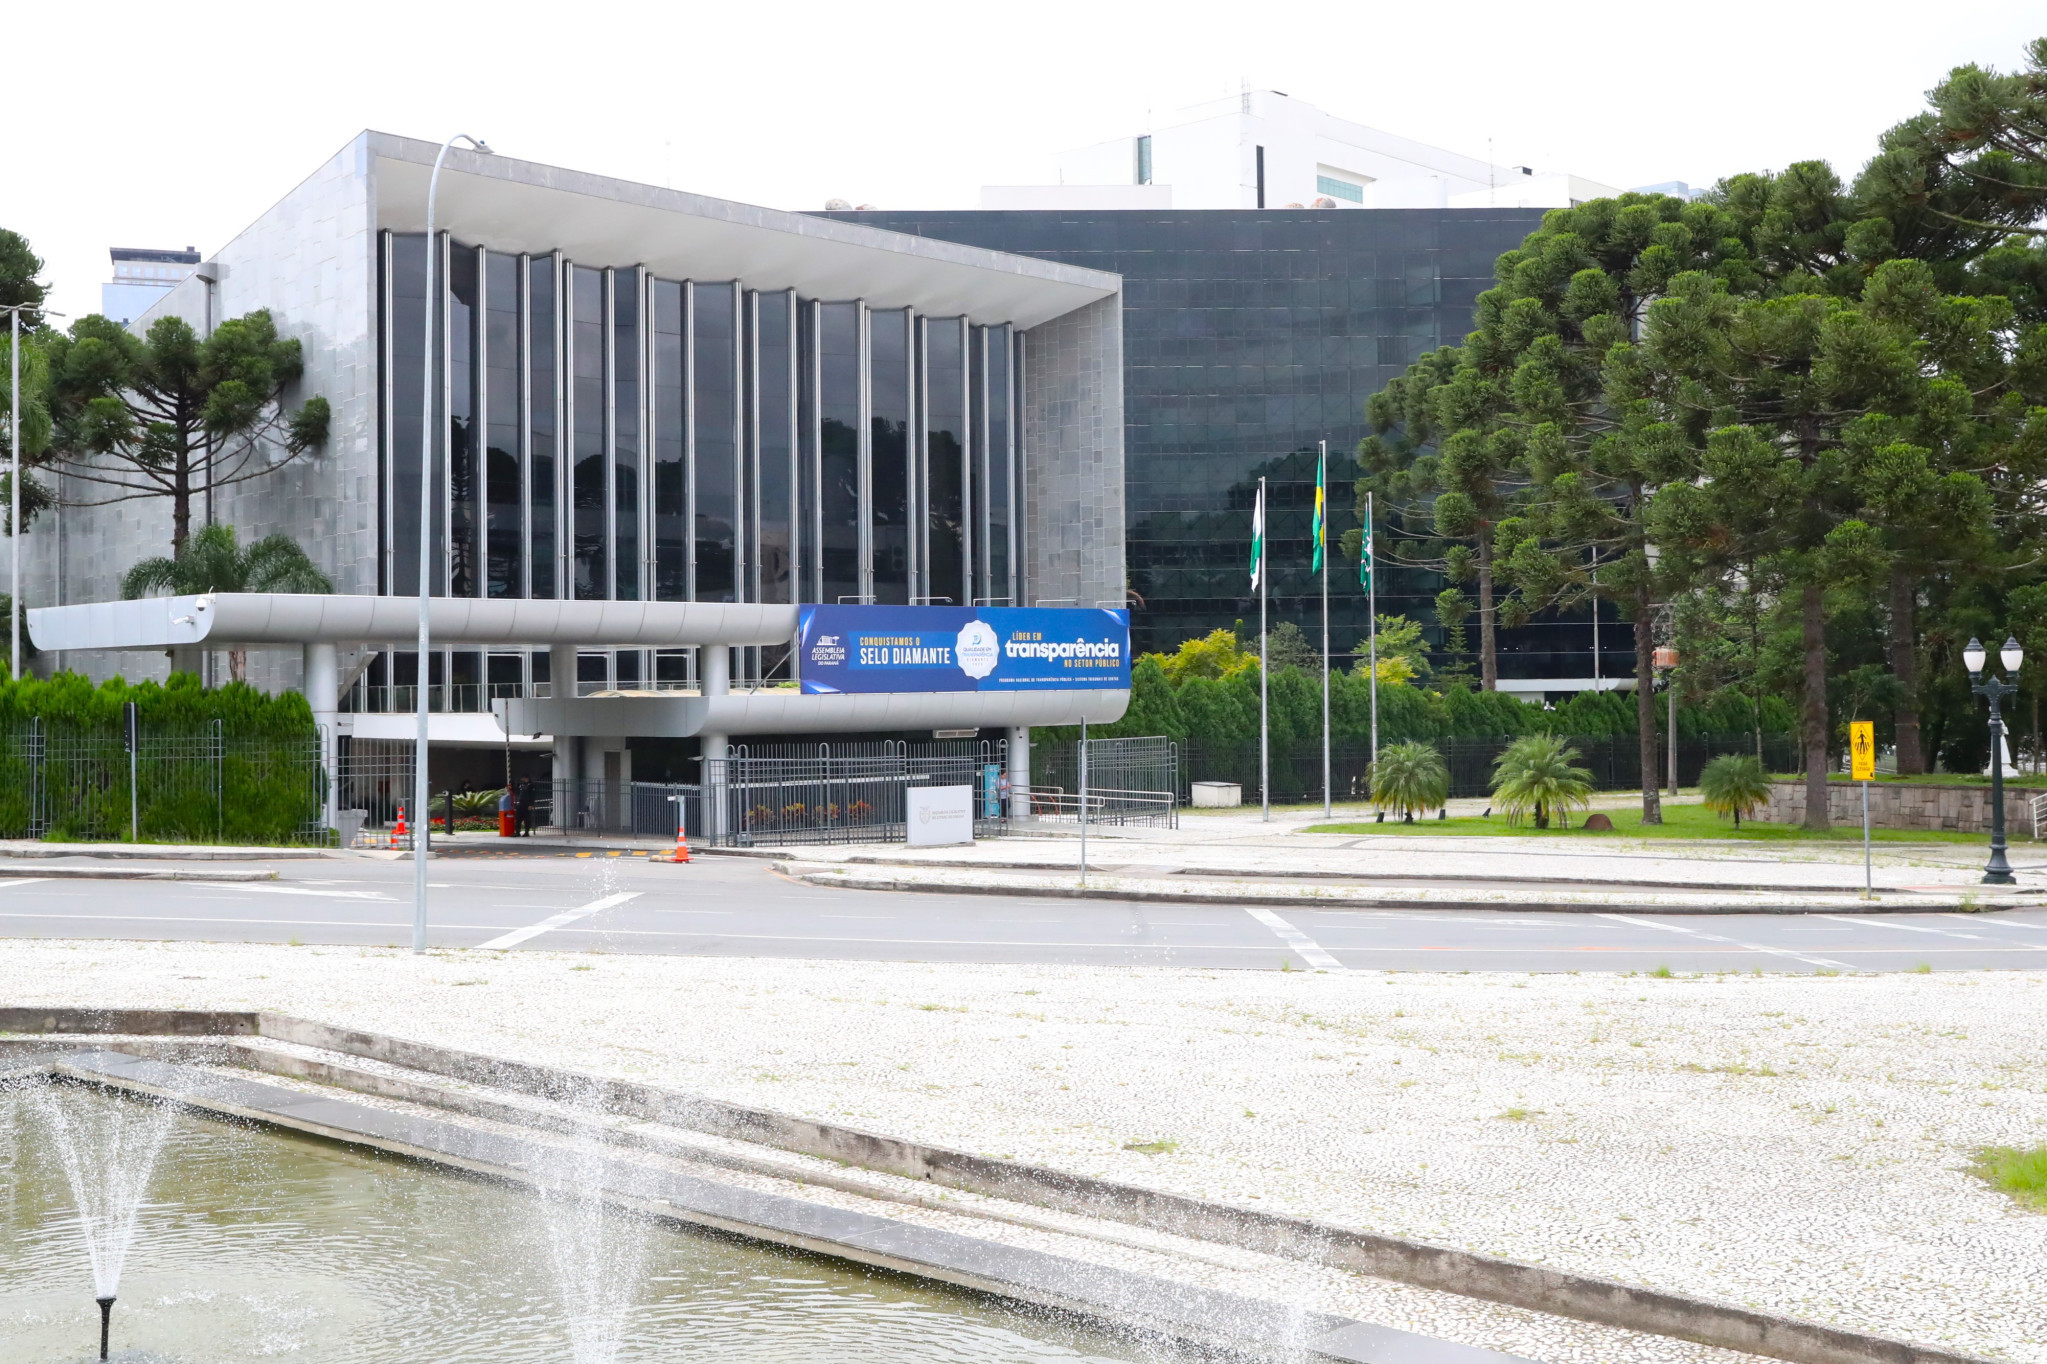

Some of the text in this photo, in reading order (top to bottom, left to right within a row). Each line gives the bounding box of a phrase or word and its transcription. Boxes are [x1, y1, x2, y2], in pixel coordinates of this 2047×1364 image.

[859, 636, 920, 646] CONQUISTAMOS O
[1012, 631, 1042, 641] LÍDER EM
[1004, 637, 1120, 663] transparência
[811, 653, 845, 661] LEGISLATIVA
[860, 647, 951, 664] SELO DIAMANTE
[1064, 658, 1120, 668] NO SETOR PÚBLICO
